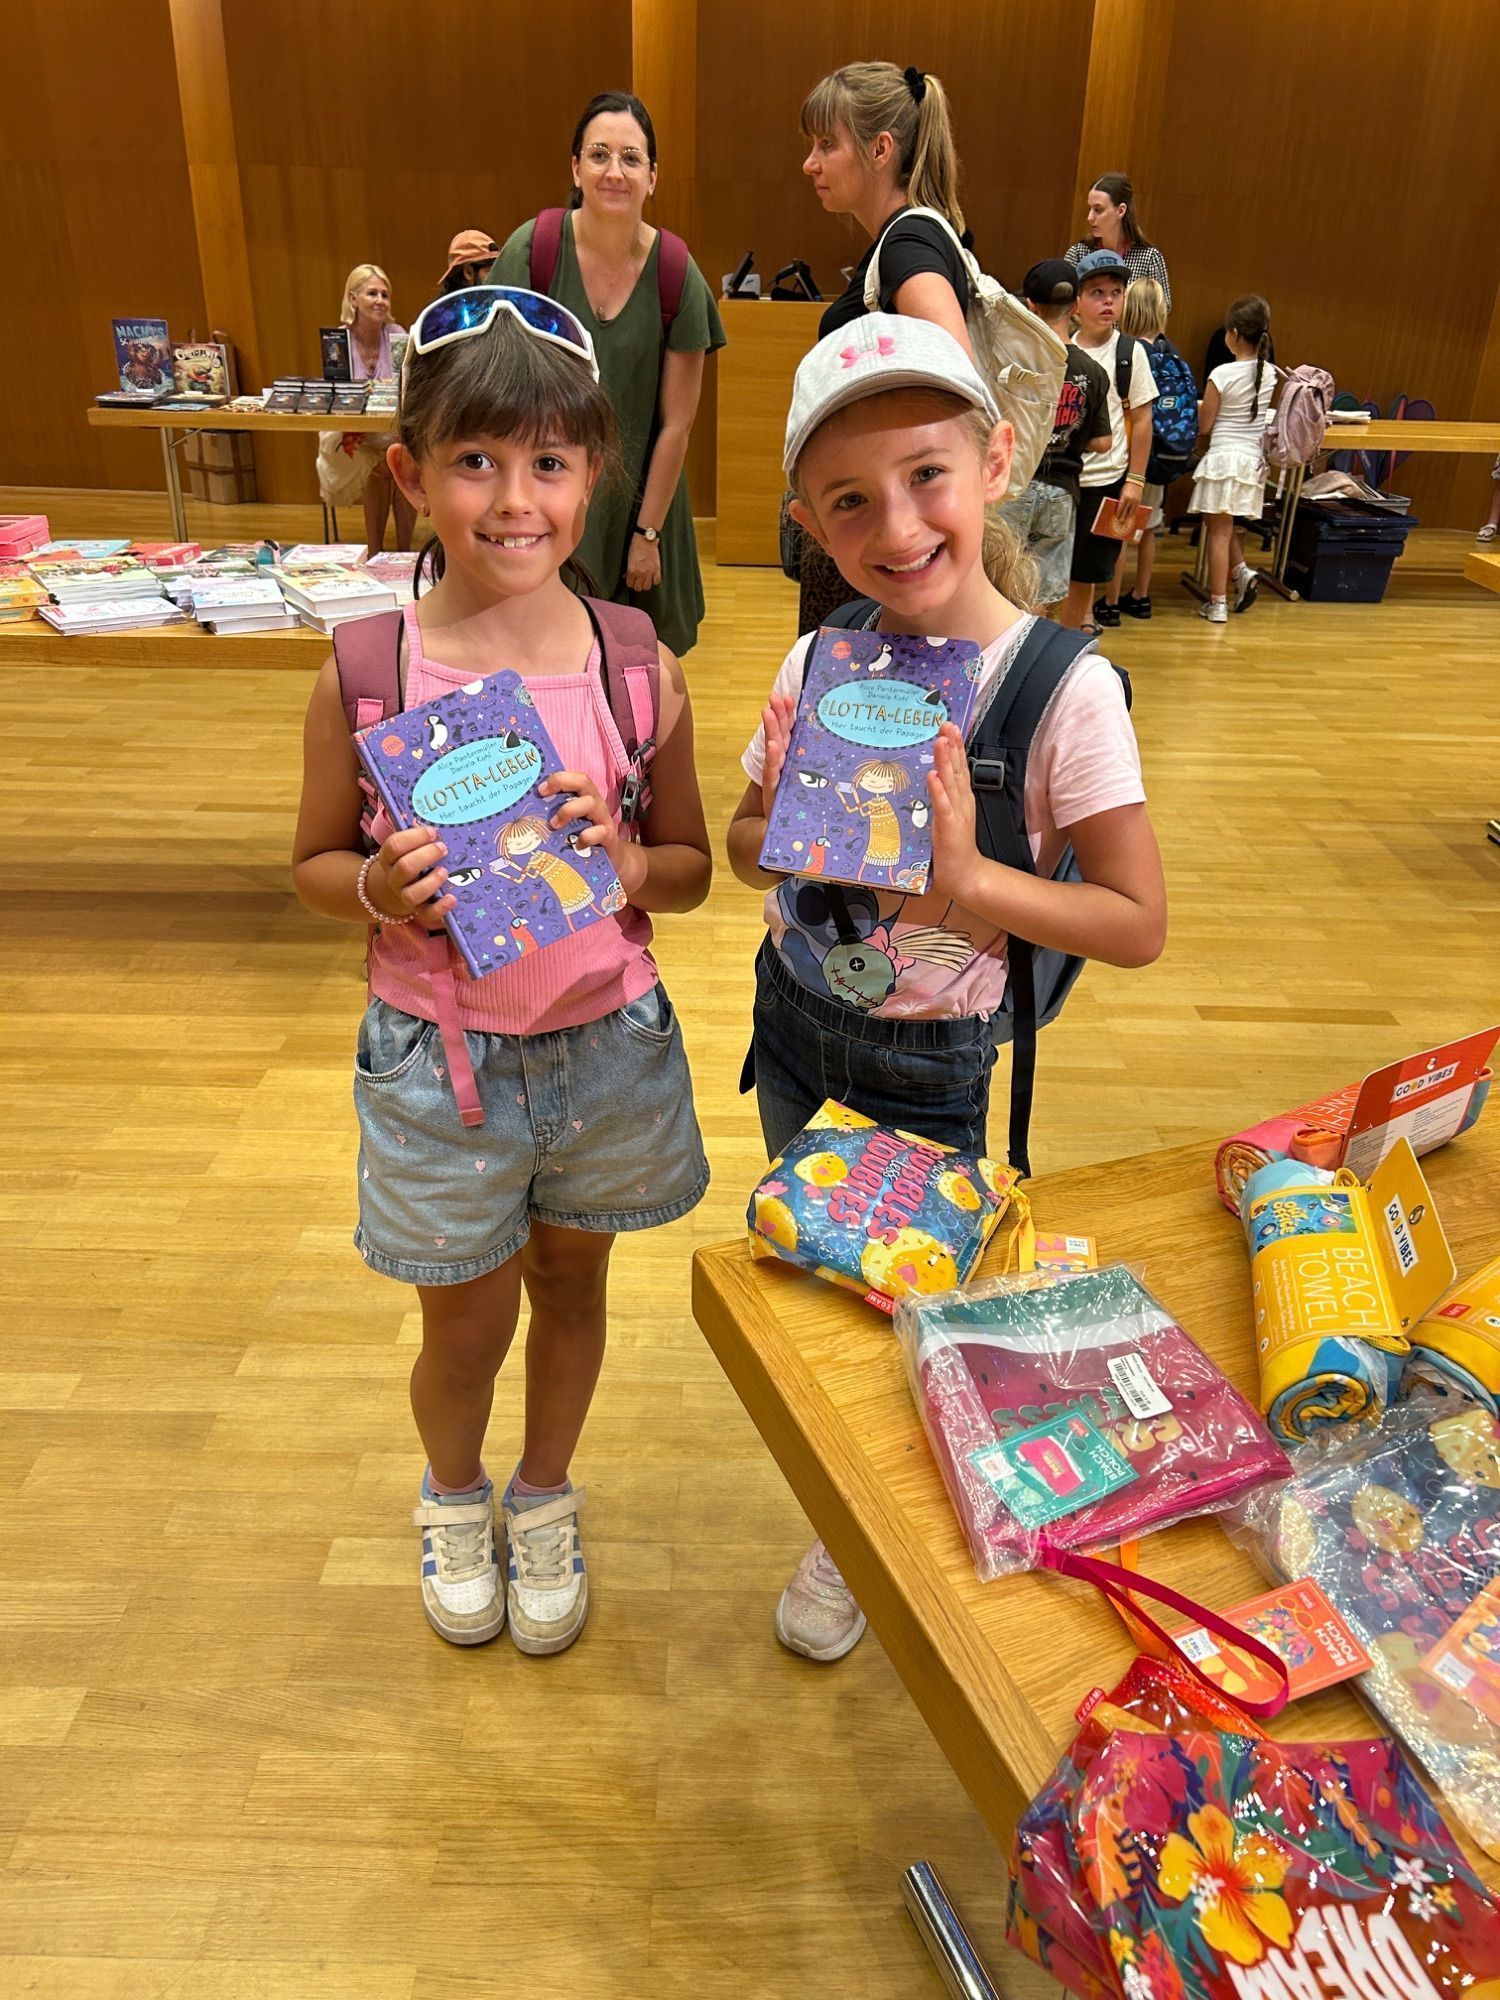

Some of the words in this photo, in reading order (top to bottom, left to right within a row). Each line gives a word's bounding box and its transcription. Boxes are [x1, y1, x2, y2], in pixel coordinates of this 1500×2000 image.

[828, 699, 945, 728] LOTTA-LEBEN
[831, 721, 847, 729] Hier
[850, 723, 877, 733] taucht
[880, 726, 892, 735] der
[896, 727, 926, 739] Papagei
[451, 758, 476, 775] Daniela
[476, 751, 493, 764] Kohl
[423, 748, 538, 812] LOTTA-LEBEN
[439, 809, 456, 821] Hier
[457, 796, 487, 812] taucht
[488, 787, 501, 800] der
[503, 775, 534, 793] Papagei
[1395, 1078, 1425, 1097] GOOD
[1427, 1065, 1455, 1085] VIBES
[1296, 1090, 1360, 1117] OWEL
[883, 1160, 910, 1181] less
[924, 1160, 948, 1190] more
[865, 1144, 945, 1247] BUBBLES
[1399, 1232, 1415, 1269] VIBES
[867, 1291, 894, 1311] EGAMI
[1296, 1249, 1339, 1329] TOWEL
[1333, 1247, 1381, 1327] BEACH
[1088, 1449, 1118, 1481] BEACH
[1094, 1443, 1127, 1477] POUCH
[1314, 1627, 1347, 1667] BEACH
[1323, 1619, 1358, 1663] POUCH
